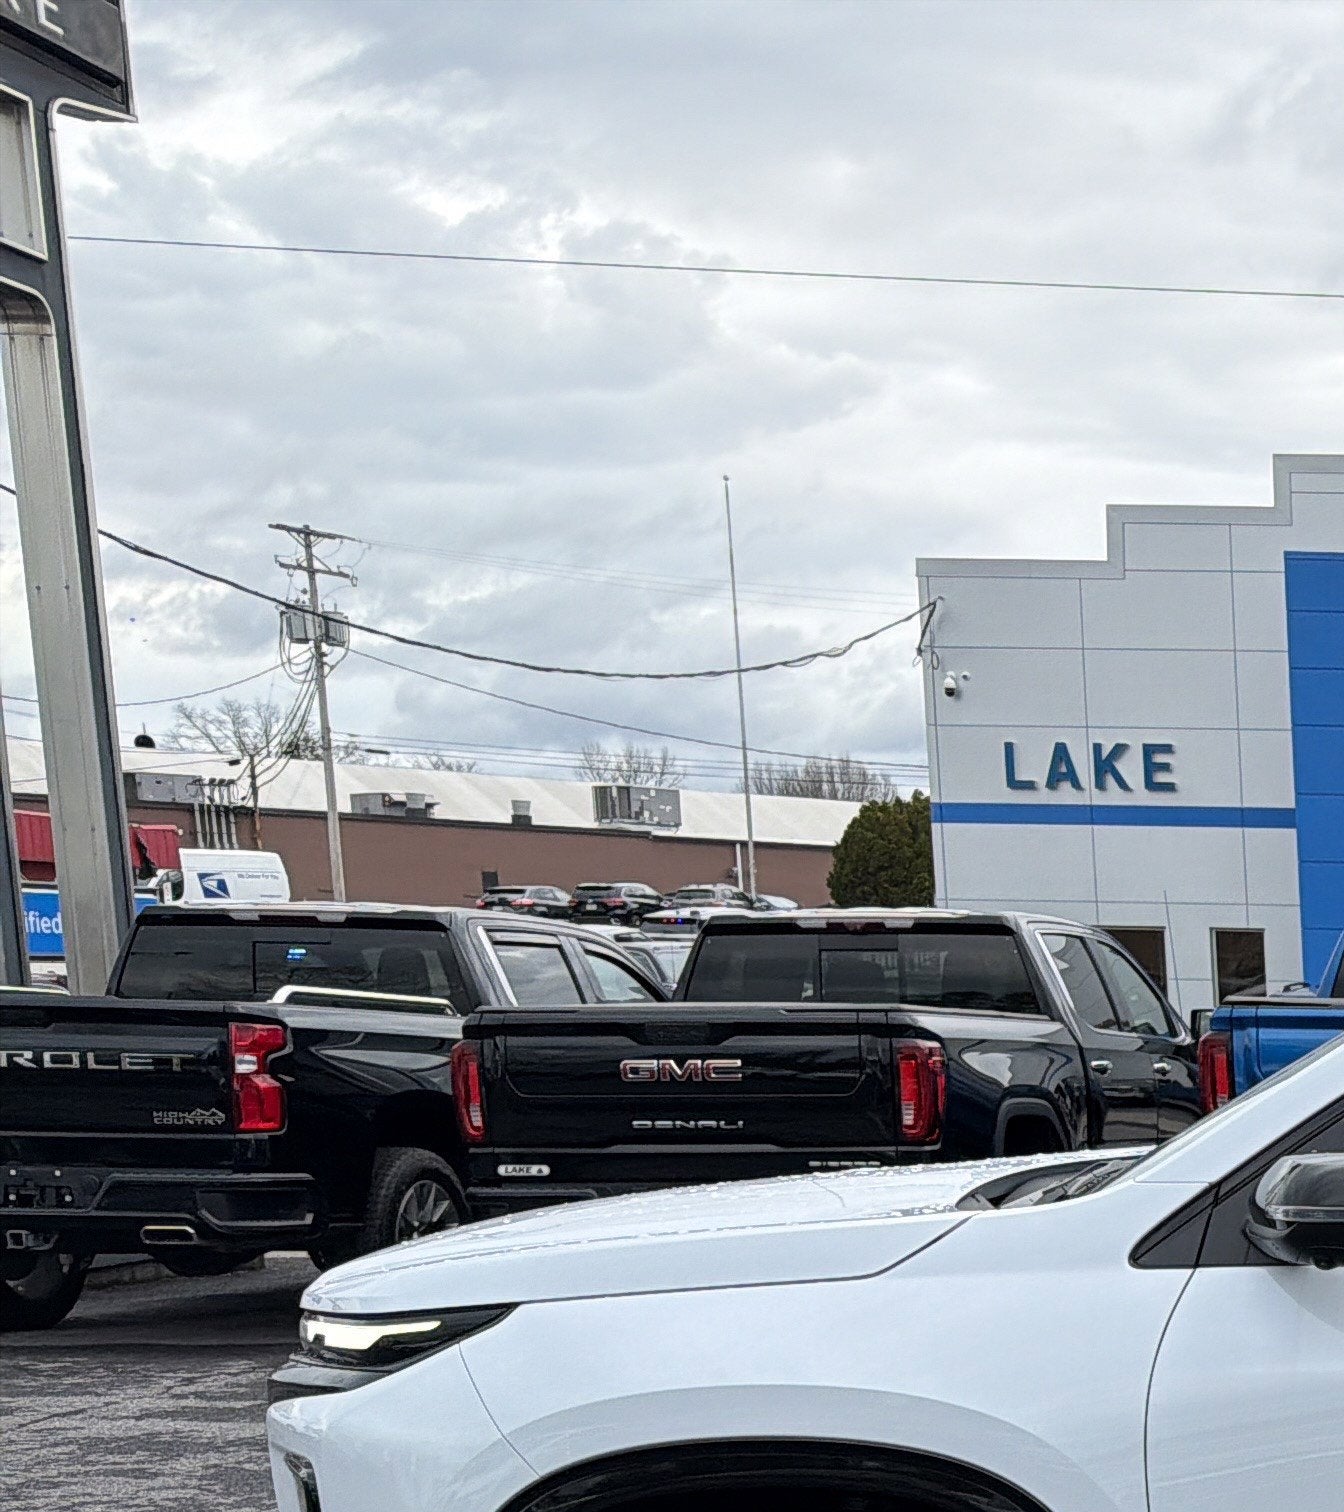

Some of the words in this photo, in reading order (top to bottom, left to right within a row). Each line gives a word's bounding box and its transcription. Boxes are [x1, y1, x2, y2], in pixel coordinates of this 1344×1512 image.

[1003, 741, 1179, 793] LAKE
[619, 1058, 743, 1082] GMC
[153, 1117, 225, 1126] COUNTRY
[631, 1119, 744, 1130] DENALI
[504, 1165, 533, 1175] LAKE
